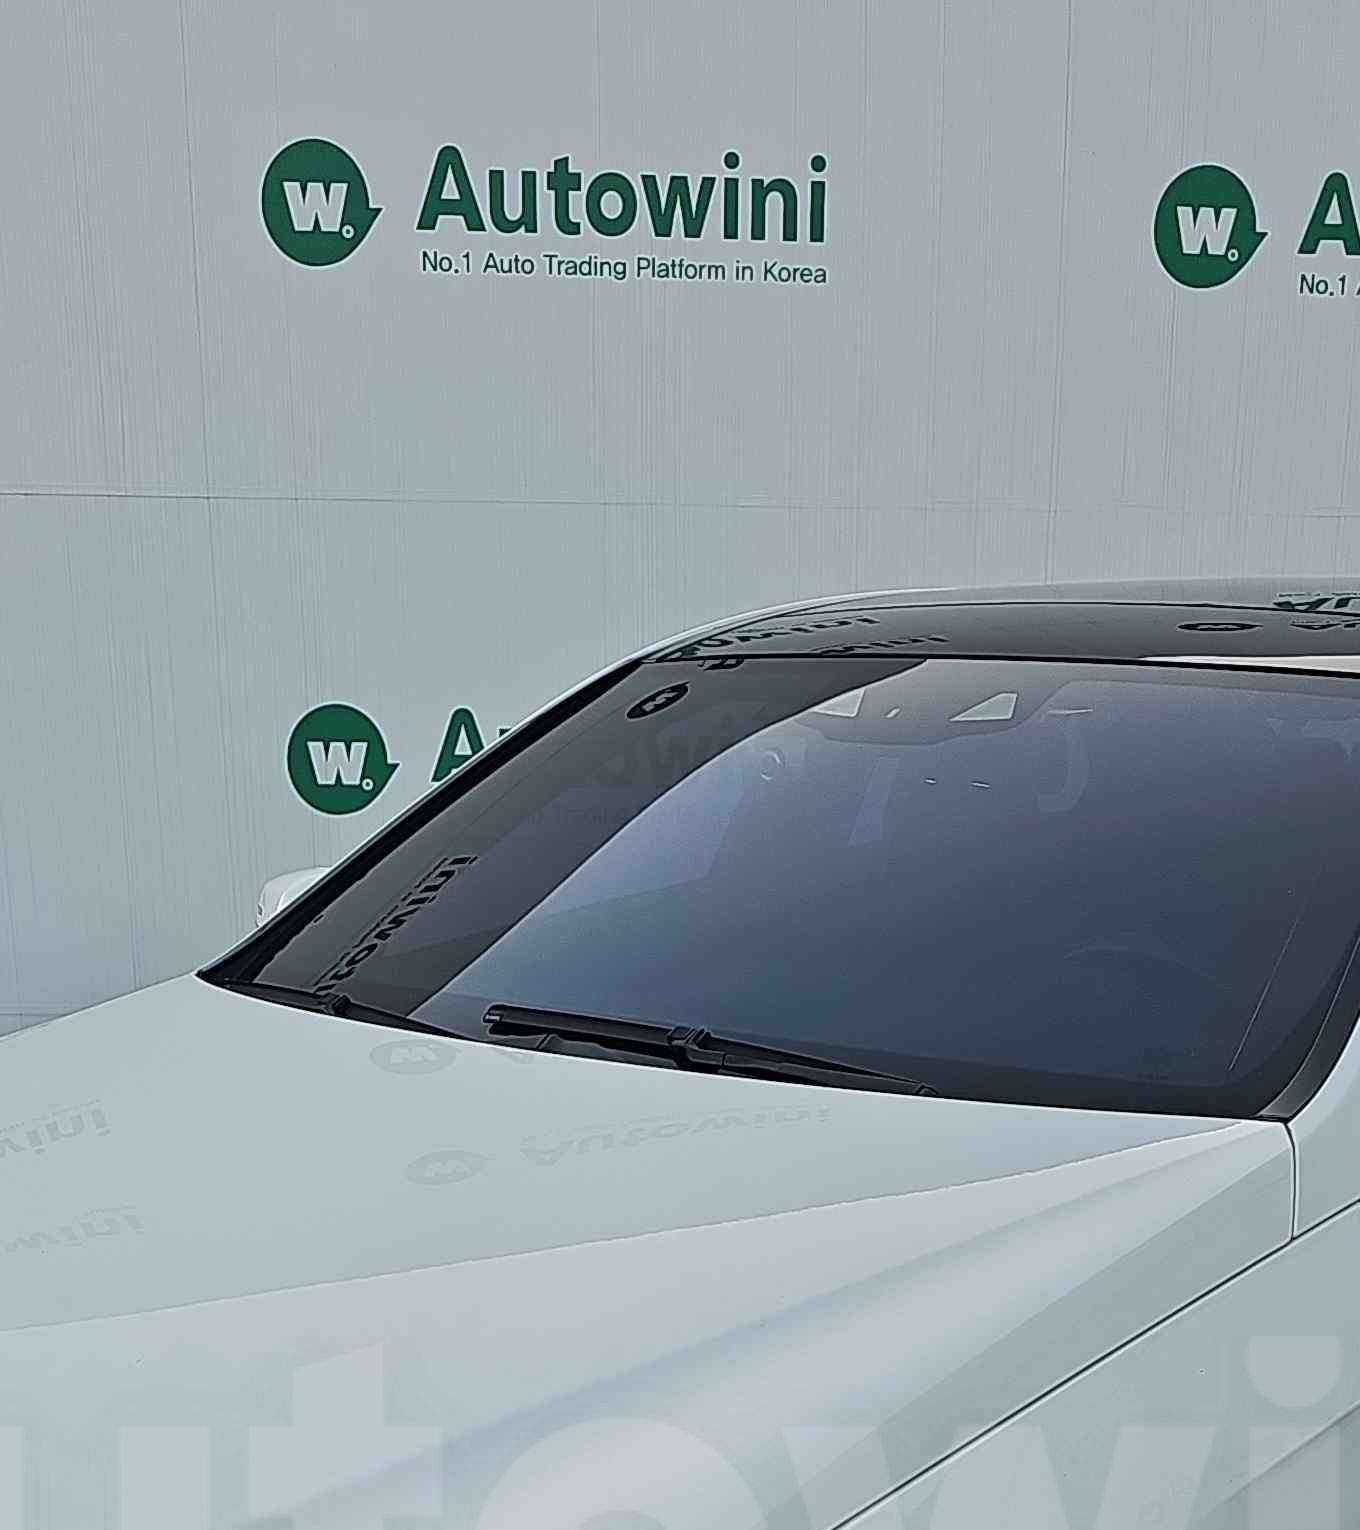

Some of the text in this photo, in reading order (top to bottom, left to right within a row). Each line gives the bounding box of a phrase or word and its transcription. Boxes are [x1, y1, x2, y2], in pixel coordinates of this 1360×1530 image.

[415, 145, 827, 243] Autowini
[422, 250, 827, 284] No.1 Auto Trading Platform in Korea
[1299, 273, 1346, 297] No.1
